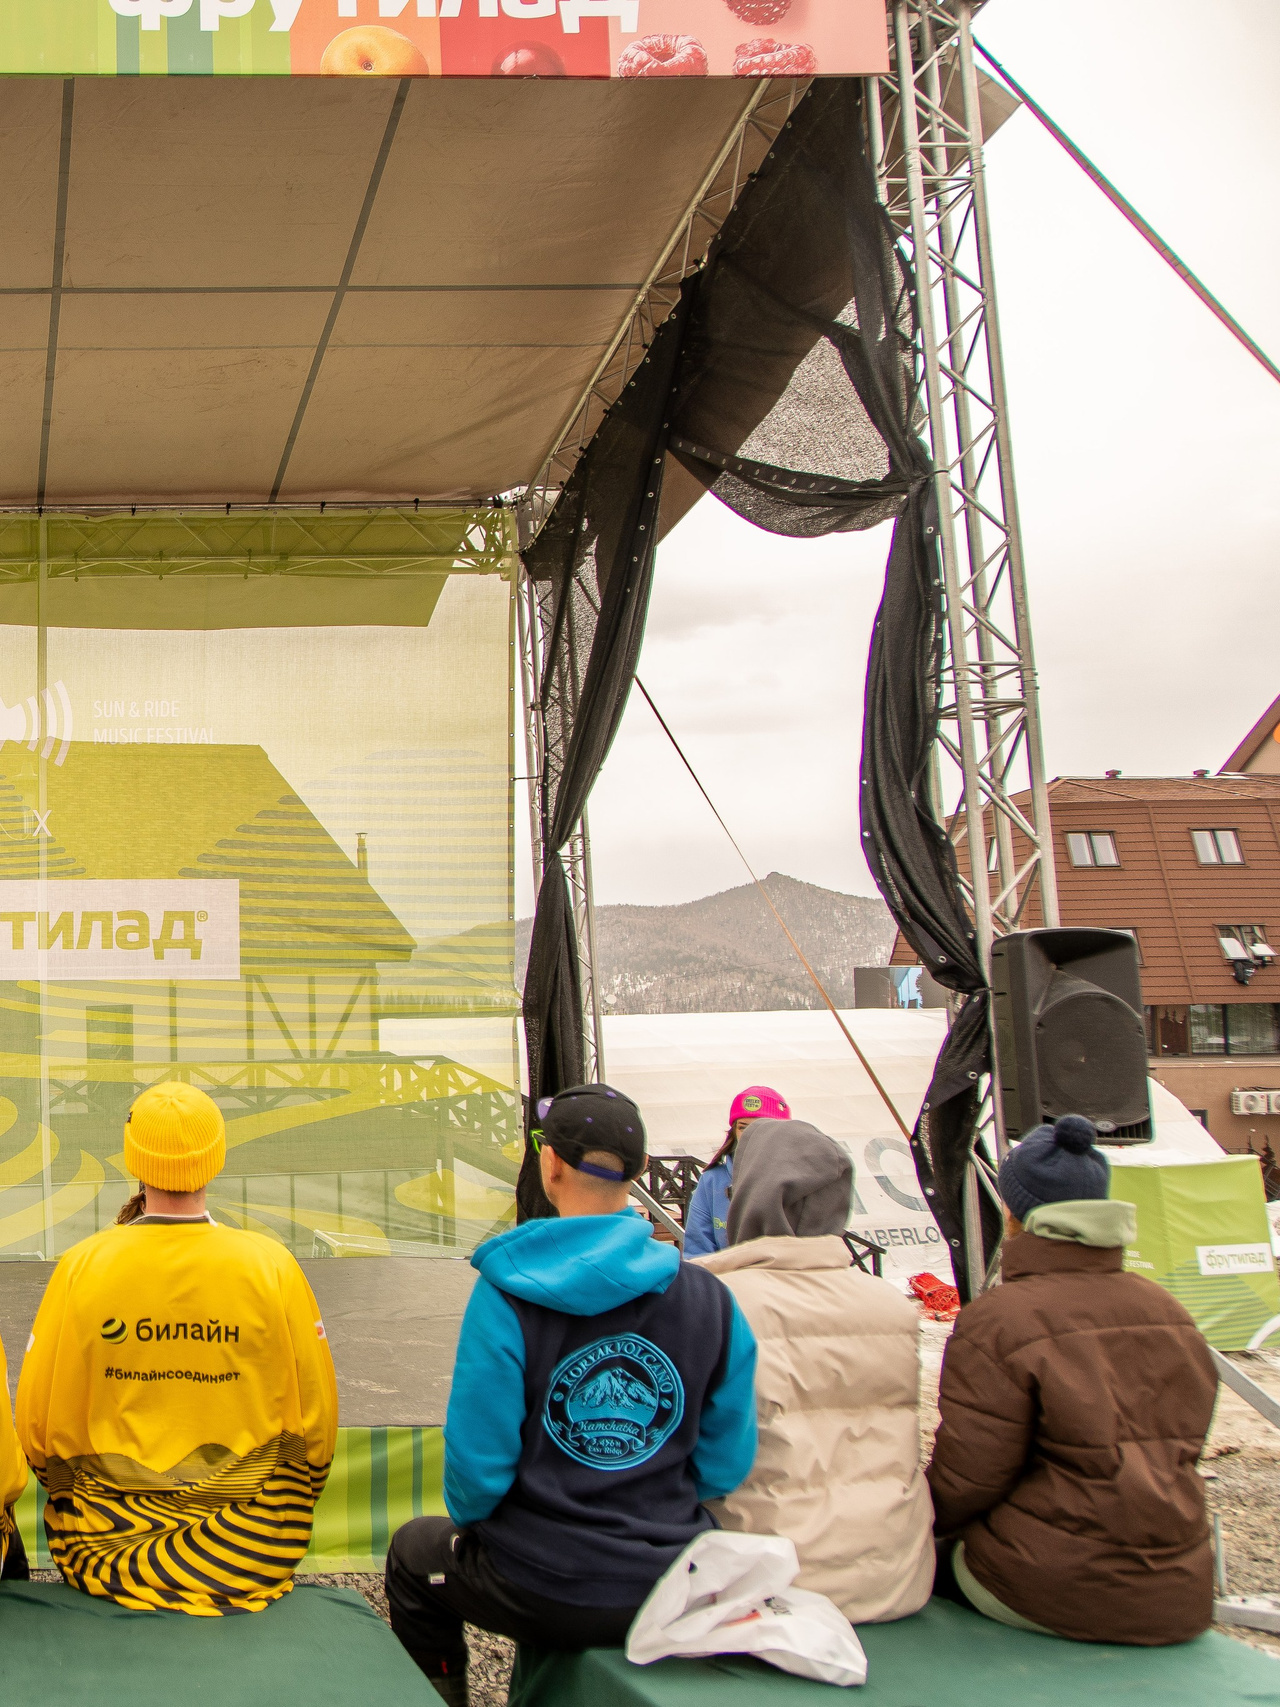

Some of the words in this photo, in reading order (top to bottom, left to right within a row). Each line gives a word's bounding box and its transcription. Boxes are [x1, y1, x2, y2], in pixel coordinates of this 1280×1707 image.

[93, 700, 124, 718] SUN
[128, 700, 140, 718] &
[144, 700, 180, 718] RIDE
[93, 727, 143, 745] MUSIC
[146, 726, 217, 745] FESTIVAL
[136, 1318, 240, 1344] билайн
[104, 1366, 241, 1384] #билайнсоединяет
[560, 1343, 614, 1389] KORYAK
[614, 1340, 674, 1393] VOLCANO
[576, 1420, 640, 1437] Kamchatka
